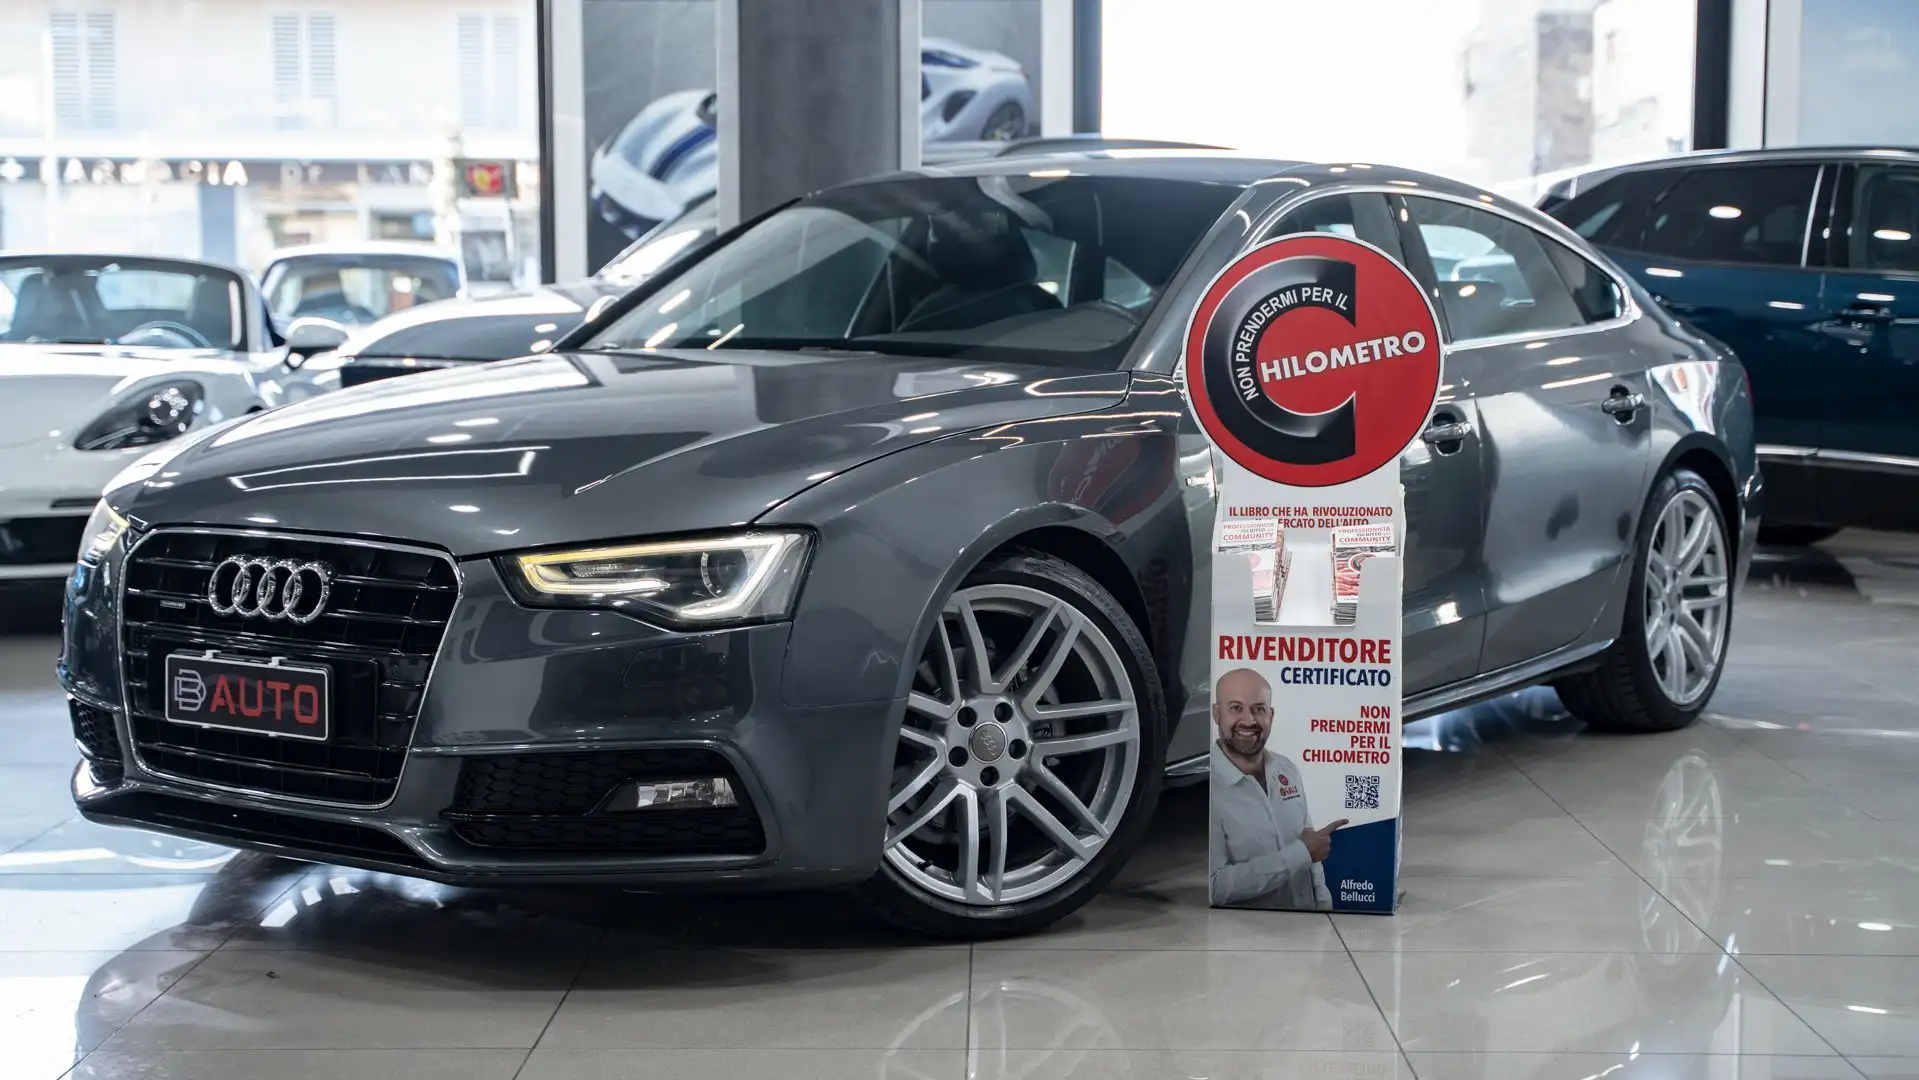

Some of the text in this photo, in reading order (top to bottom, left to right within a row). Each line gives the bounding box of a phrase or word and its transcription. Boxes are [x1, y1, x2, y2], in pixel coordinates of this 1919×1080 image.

[1236, 287, 1349, 401] NON PRENDERMI PER IL
[1229, 506, 1393, 517] IL LIBRO CHE HA RIVOLUZIONATO
[1276, 518, 1316, 529] ERCATO
[1223, 532, 1274, 541] COMMUNITY
[1218, 635, 1391, 664] RIVENDITORE
[1281, 667, 1391, 687] CERTIFICATO
[210, 674, 319, 724] AUTO
[1360, 705, 1391, 719] NON
[1311, 719, 1390, 734] PRENDERMI
[1350, 735, 1391, 750] PER IL
[1302, 749, 1390, 764] CHILOMETRO
[1340, 879, 1374, 891] Alfredo
[1340, 891, 1376, 903] Bellucci
